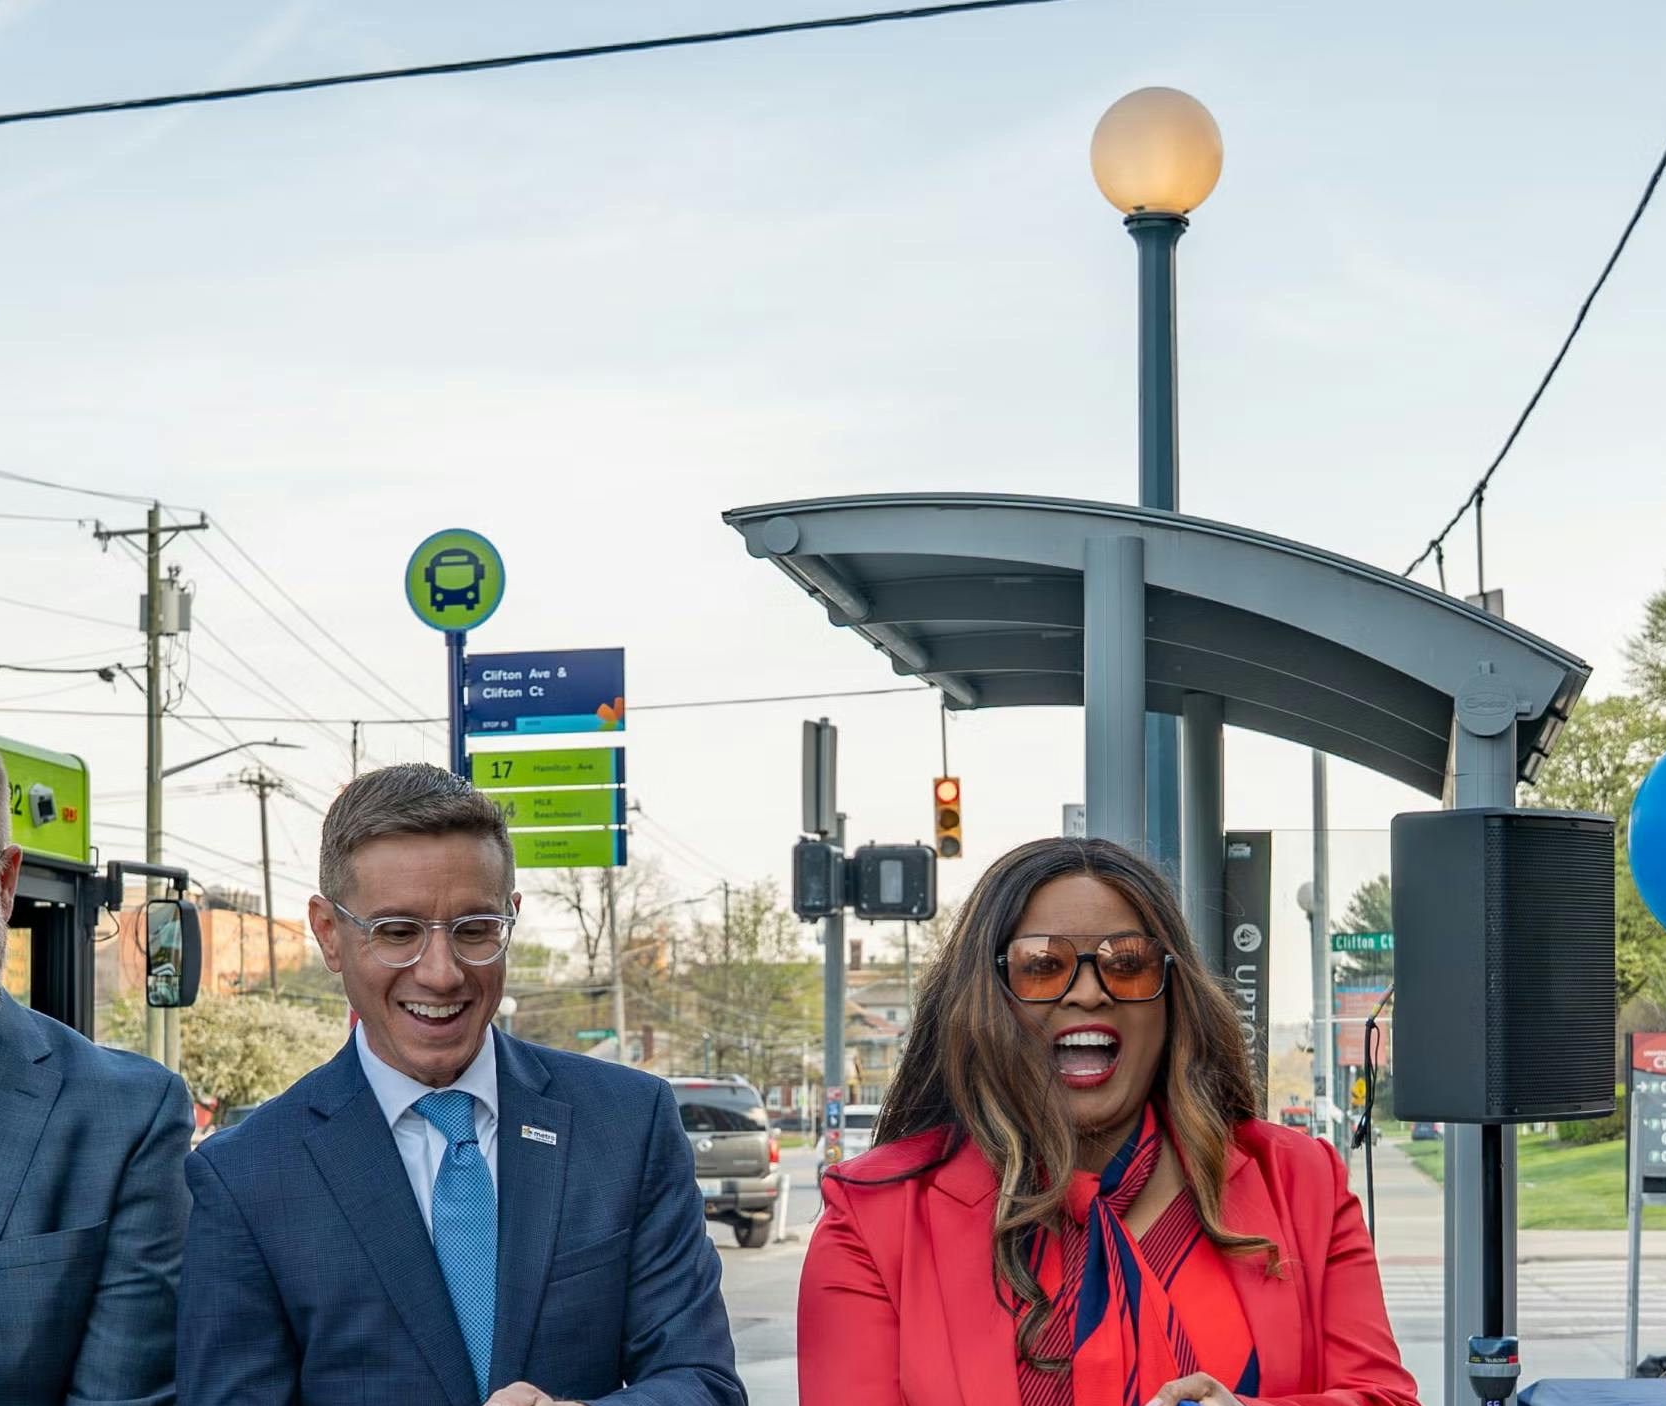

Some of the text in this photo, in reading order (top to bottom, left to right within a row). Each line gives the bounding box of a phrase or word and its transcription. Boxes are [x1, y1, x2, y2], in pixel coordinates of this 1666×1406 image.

[482, 667, 567, 681] Clifton Ave &
[482, 686, 544, 699] Clifton Ct
[491, 760, 514, 779] 17
[1336, 935, 1374, 950] Clifton
